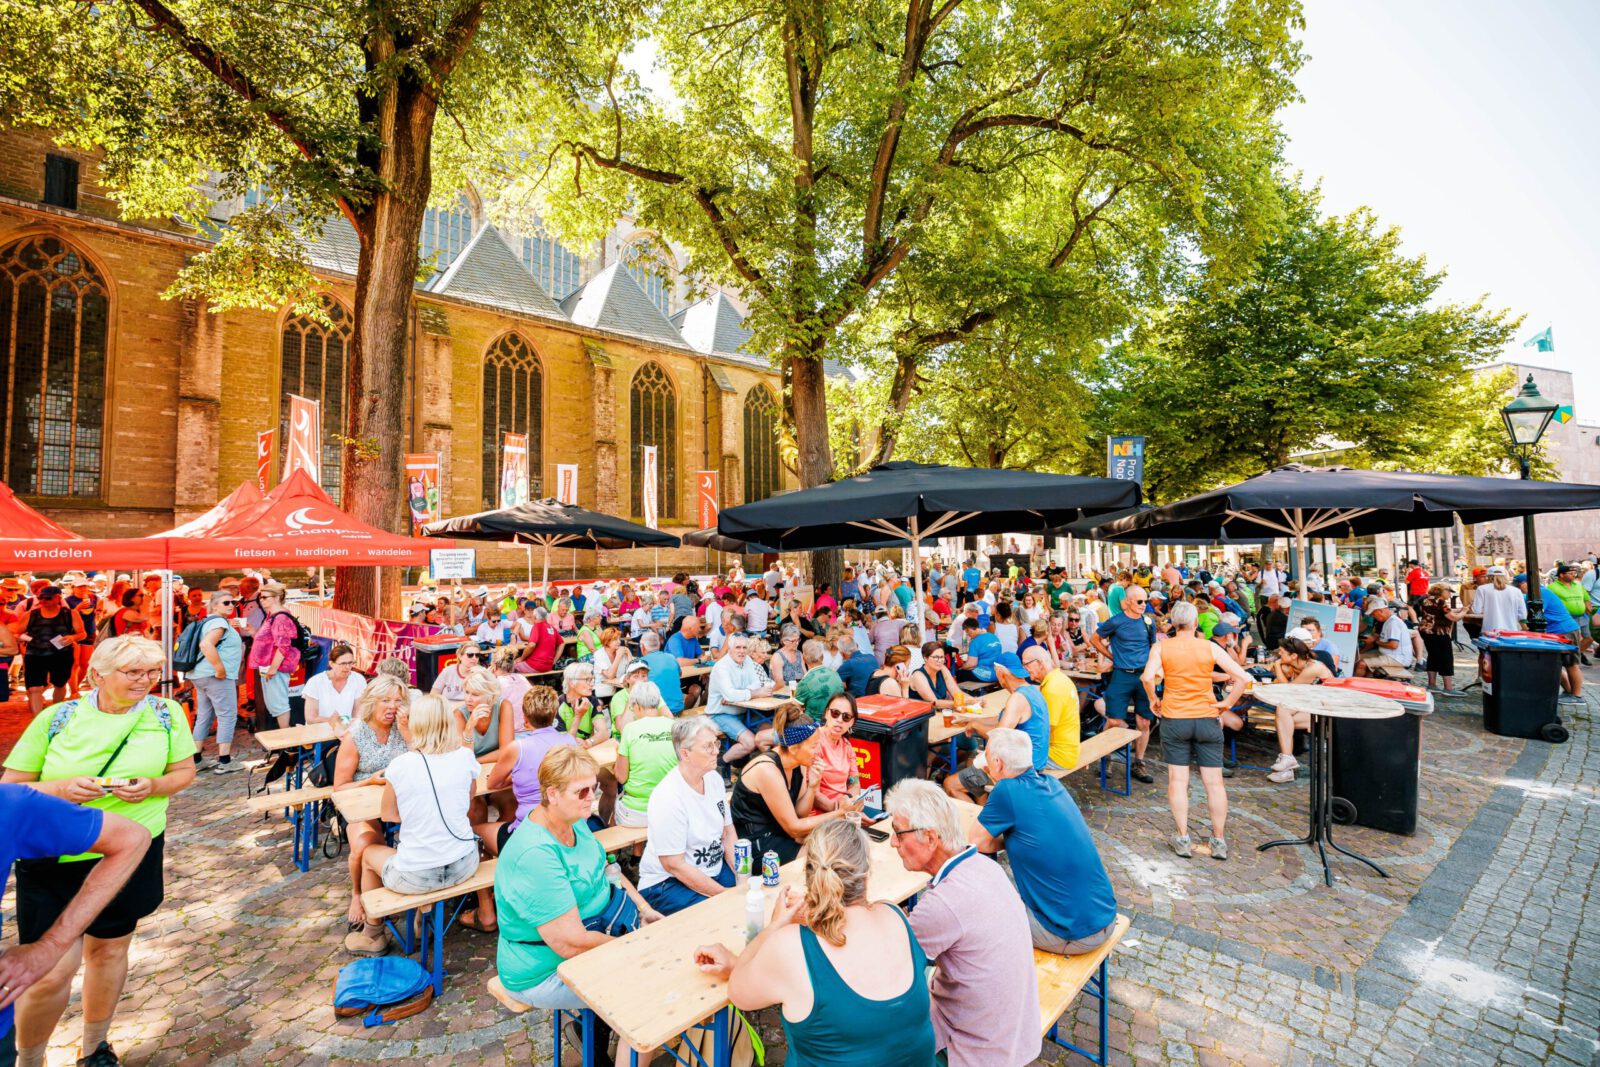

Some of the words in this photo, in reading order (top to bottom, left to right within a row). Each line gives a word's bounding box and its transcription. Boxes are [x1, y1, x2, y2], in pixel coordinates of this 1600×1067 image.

[13, 547, 93, 559] wandelen
[234, 547, 276, 558] fietsen
[295, 547, 349, 558] hardlopen
[368, 548, 412, 556] wandelen
